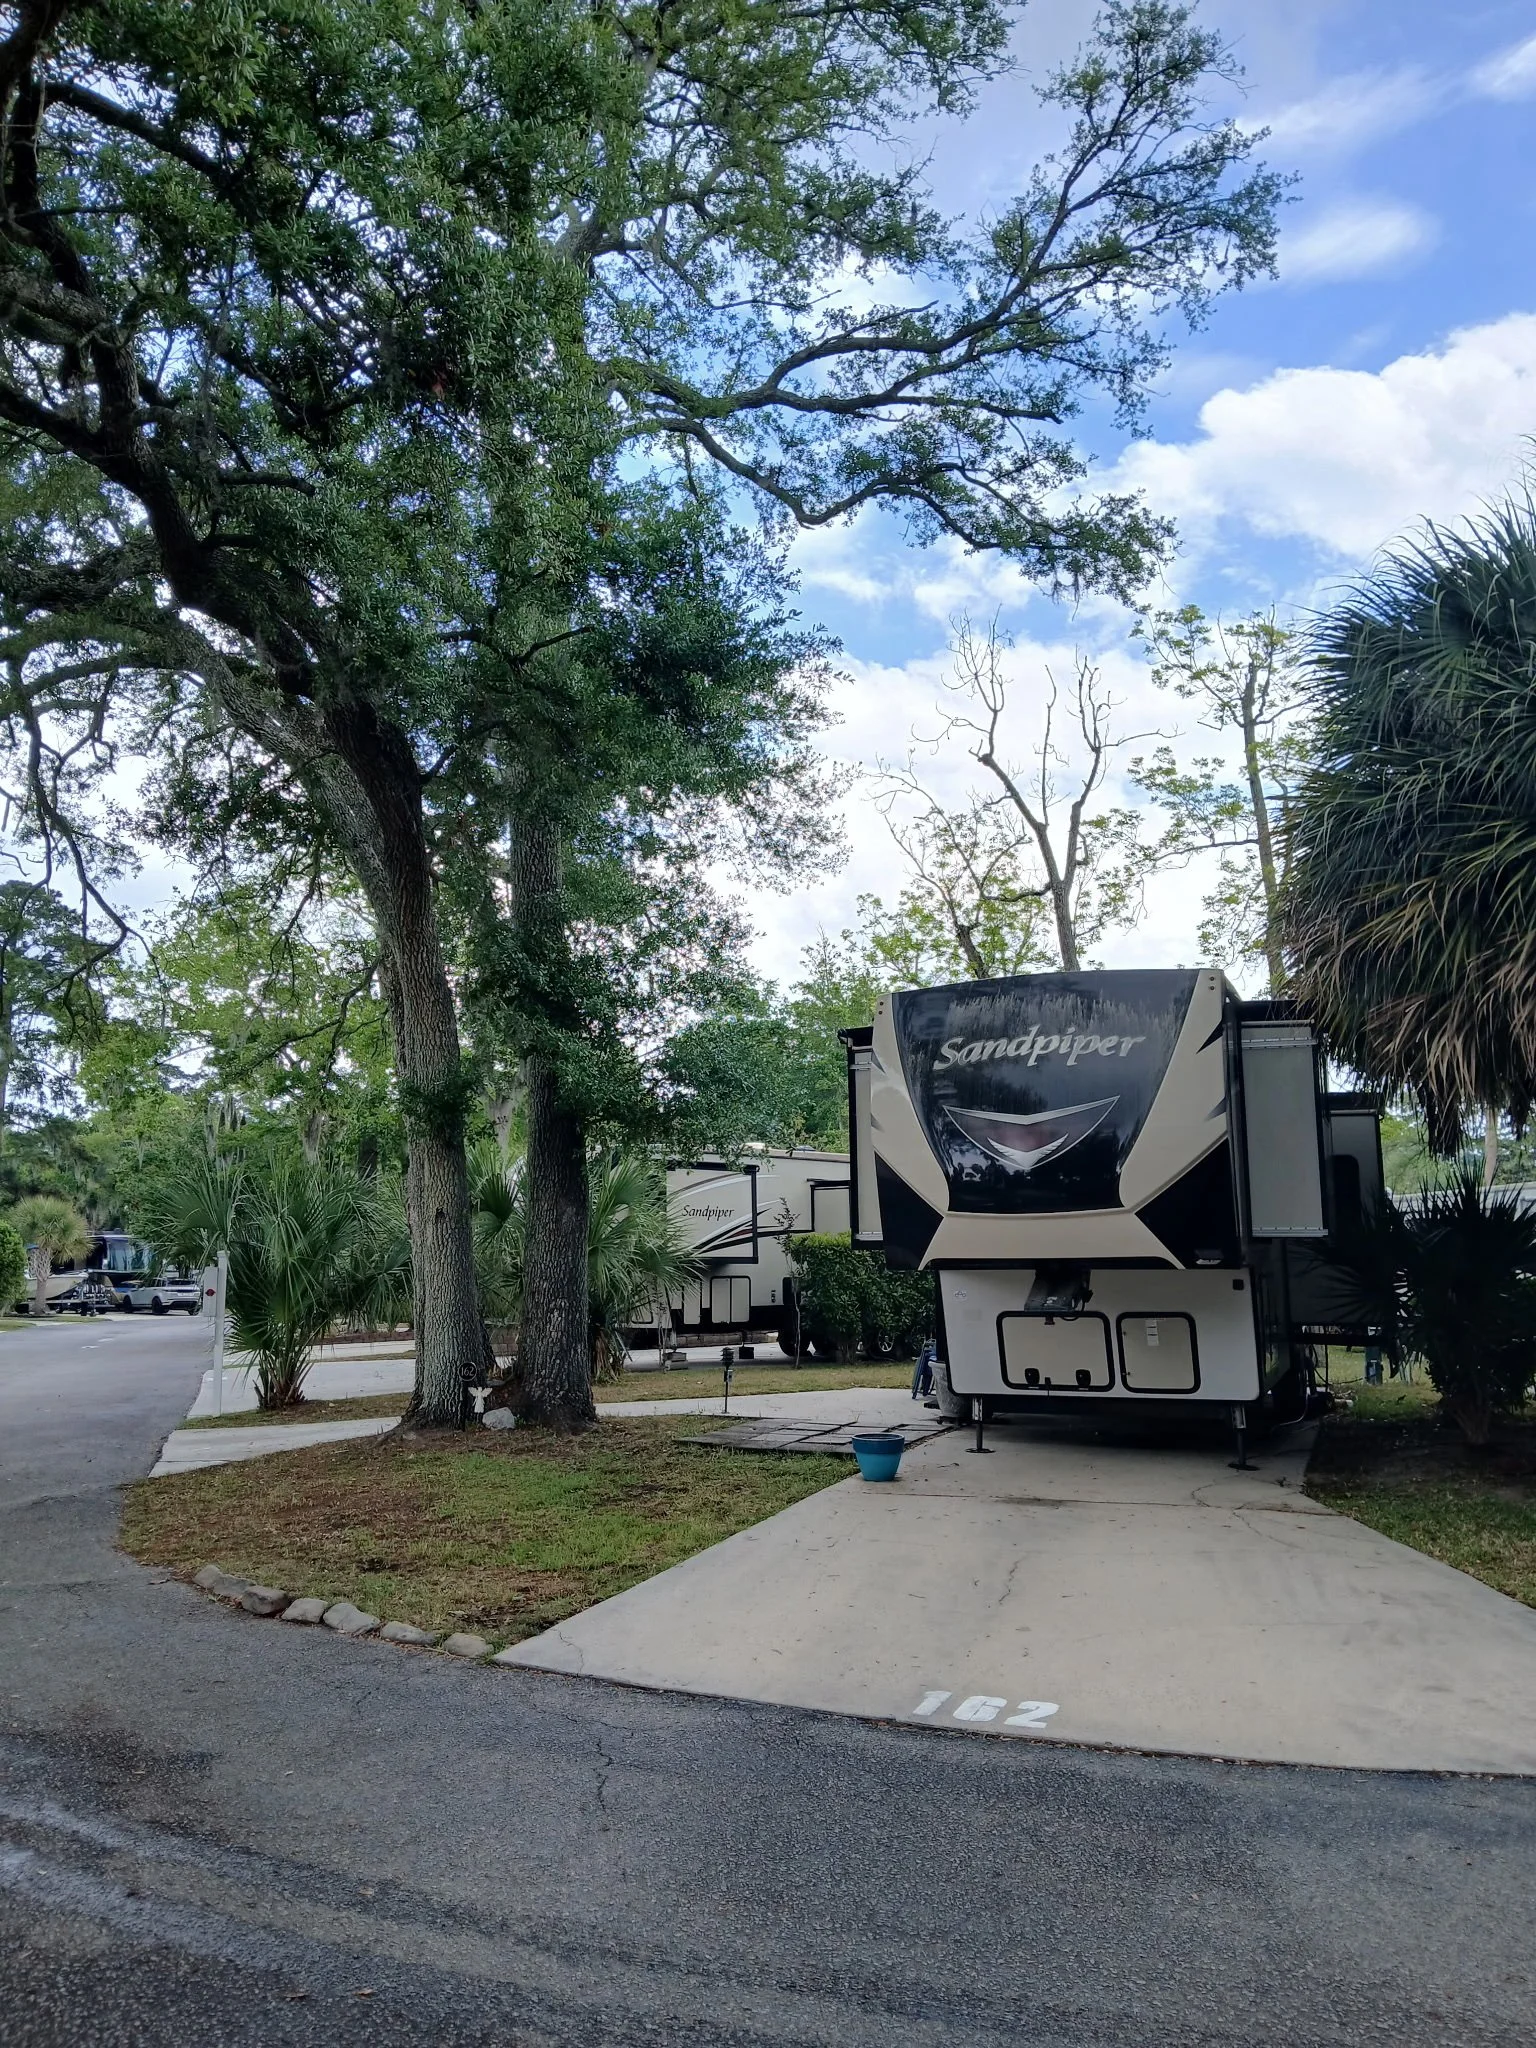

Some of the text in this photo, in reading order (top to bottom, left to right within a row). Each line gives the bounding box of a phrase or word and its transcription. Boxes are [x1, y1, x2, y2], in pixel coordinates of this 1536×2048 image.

[933, 1023, 1147, 1070] Sandpiper
[681, 1204, 735, 1221] Sandpiper
[461, 1366, 475, 1376] 162
[912, 1690, 1061, 1729] 162
